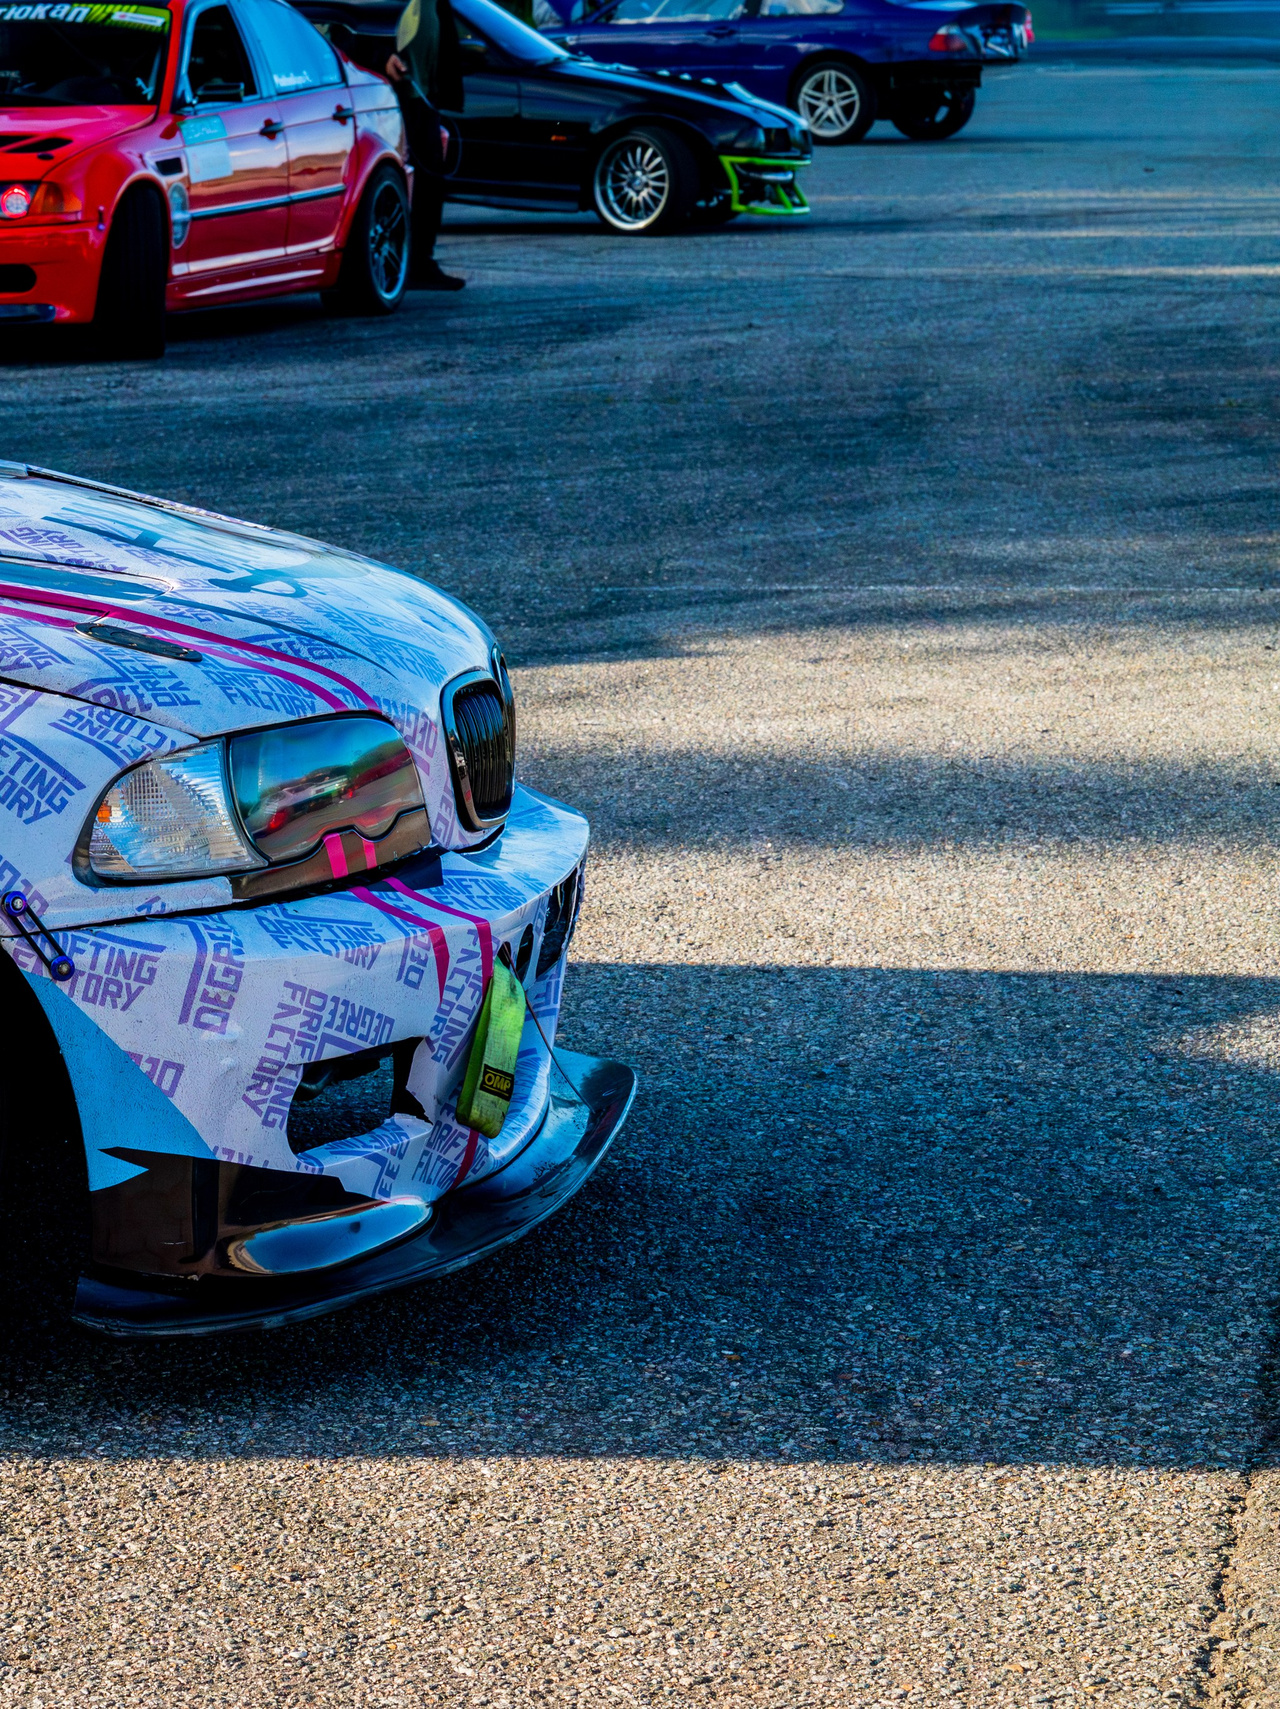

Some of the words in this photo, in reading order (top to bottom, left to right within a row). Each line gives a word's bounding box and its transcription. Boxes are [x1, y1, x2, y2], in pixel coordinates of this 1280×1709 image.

[256, 914, 386, 945] DRIFTING
[270, 933, 383, 970] FACTORY
[241, 980, 308, 1118] FACTORY
[484, 1071, 512, 1093] OMP
